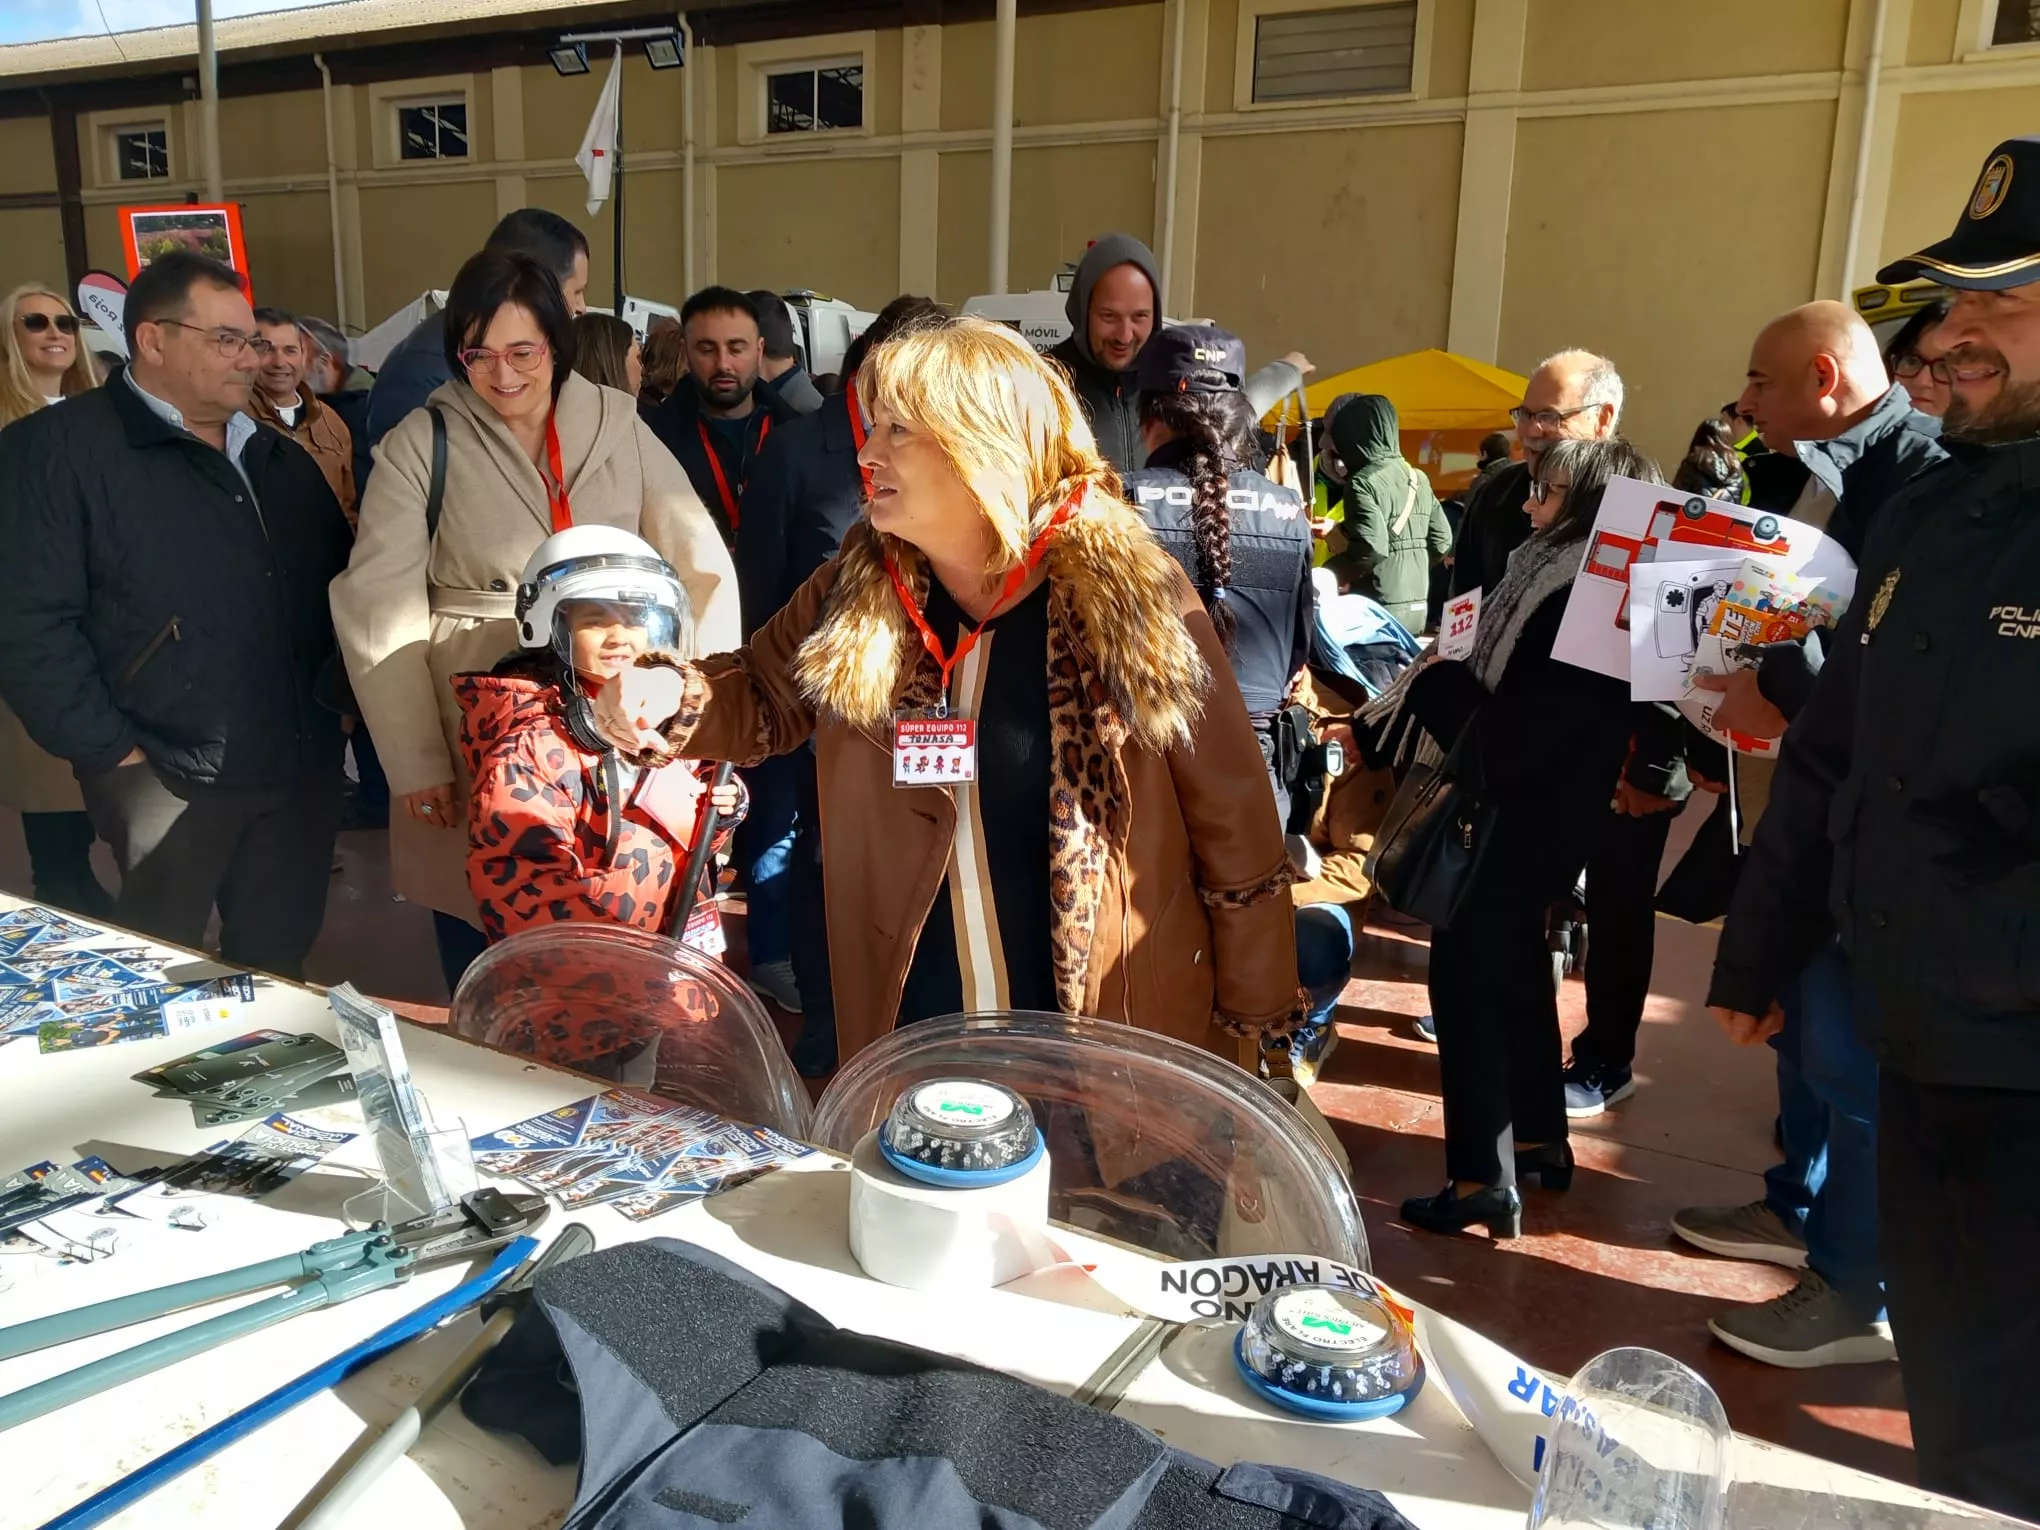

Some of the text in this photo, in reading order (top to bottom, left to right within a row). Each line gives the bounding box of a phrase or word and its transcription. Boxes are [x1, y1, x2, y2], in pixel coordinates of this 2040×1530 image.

[1024, 326, 1060, 338] MÓVIL
[1194, 348, 1227, 362] CNP
[1137, 486, 1277, 512] POCIA
[1989, 606, 2040, 622] POLI
[1450, 614, 1474, 637] 112
[926, 723, 954, 733] EQUIPO
[957, 723, 967, 732] 112
[1330, 1263, 1379, 1297] DE
[1312, 1335, 1368, 1346] ELECTRO
